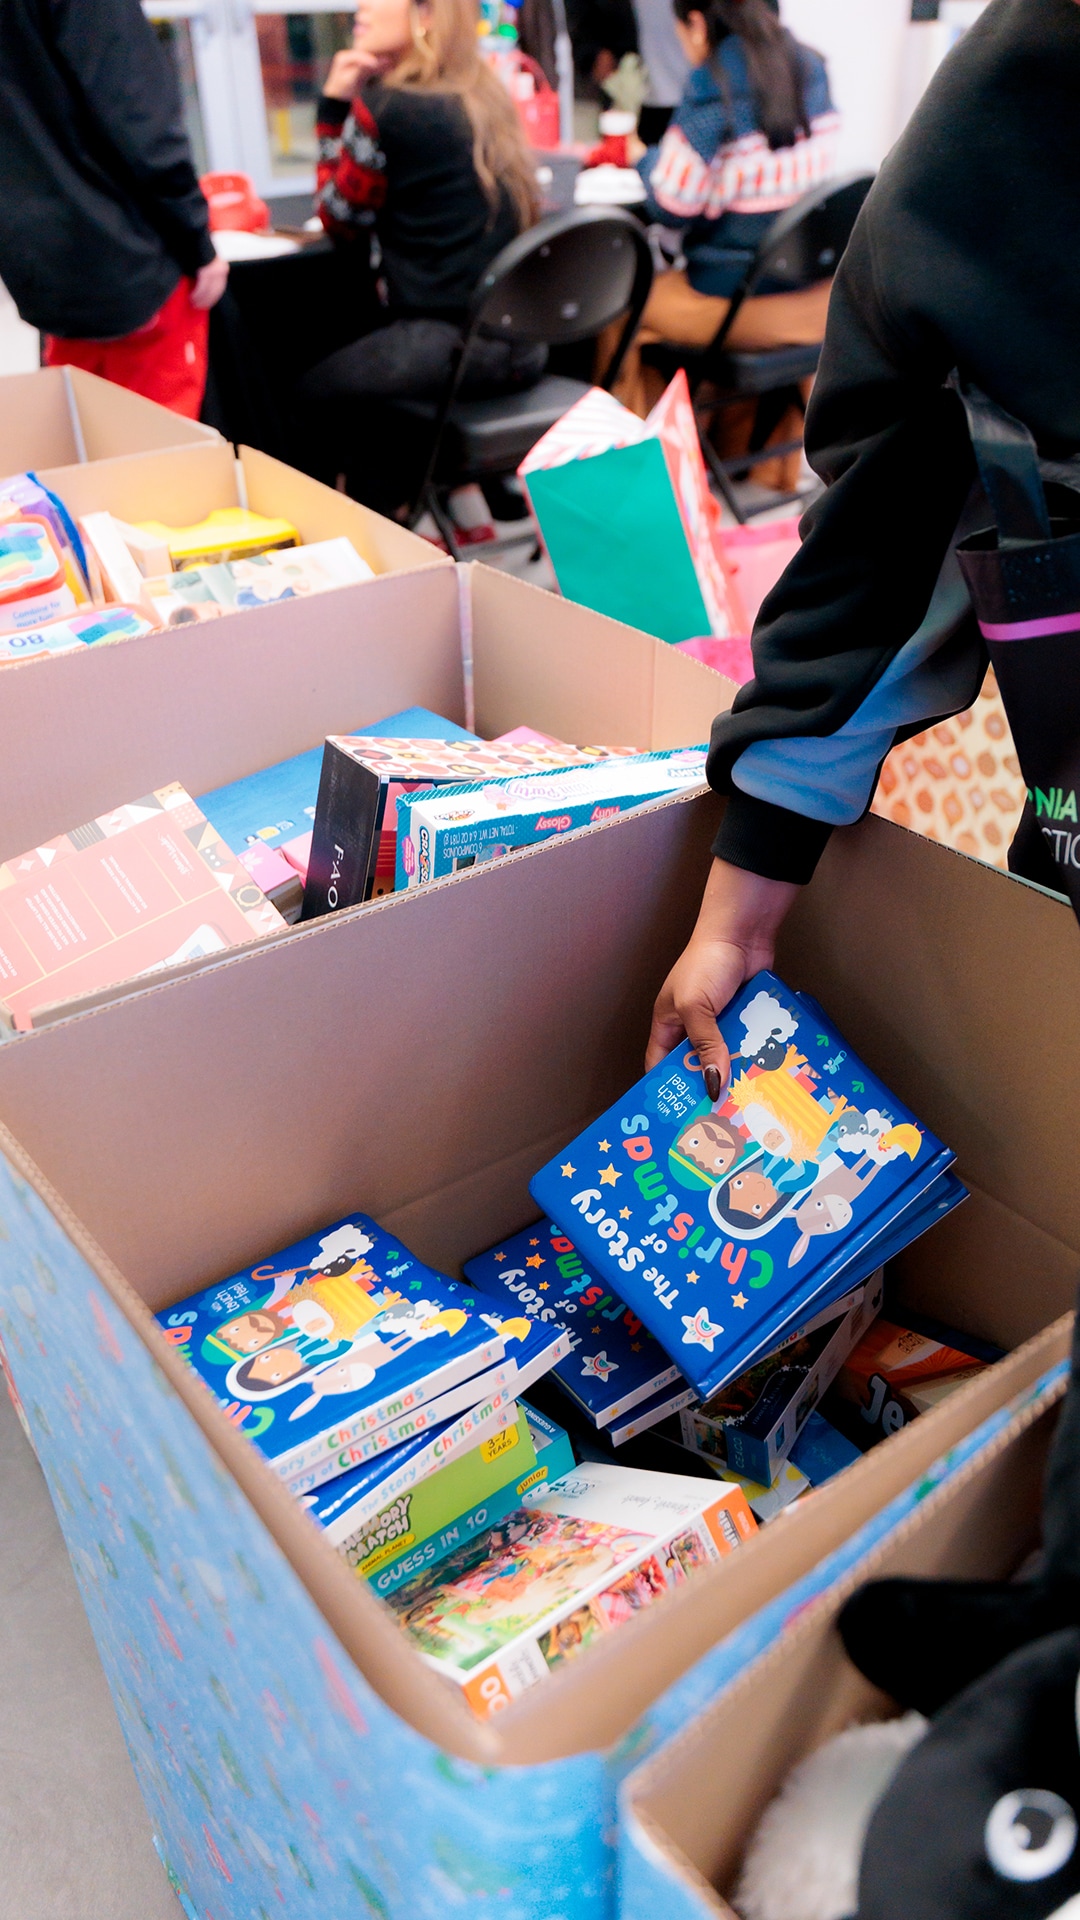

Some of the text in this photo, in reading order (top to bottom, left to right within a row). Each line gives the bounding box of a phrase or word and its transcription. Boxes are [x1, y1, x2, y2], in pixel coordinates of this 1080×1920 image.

[488, 826, 498, 838] NET
[499, 823, 515, 835] TOTAL
[535, 813, 572, 834] Glossy
[460, 831, 468, 842] OZ
[442, 842, 482, 858] 6 COMPOUNDS
[657, 1084, 688, 1119] touch
[666, 1073, 697, 1107] and feel
[657, 1101, 671, 1117] with
[621, 1114, 774, 1289] Christmas
[570, 1188, 679, 1310] The Story
[640, 1232, 668, 1254] of
[215, 1290, 240, 1314] touch
[227, 1282, 249, 1299] feel
[554, 1299, 577, 1313] of
[653, 1376, 668, 1389] The
[310, 1444, 322, 1457] of
[327, 1387, 424, 1449] Christmas
[321, 1462, 333, 1476] of
[338, 1408, 436, 1467] Christmas
[381, 1467, 417, 1500] Story
[420, 1454, 431, 1467] of
[433, 1389, 510, 1458] Christmas
[487, 1439, 513, 1457] YEARS
[349, 1515, 411, 1565] MATCH
[718, 1509, 739, 1549] uffalo
[377, 1508, 487, 1589] GUESS IN 10
